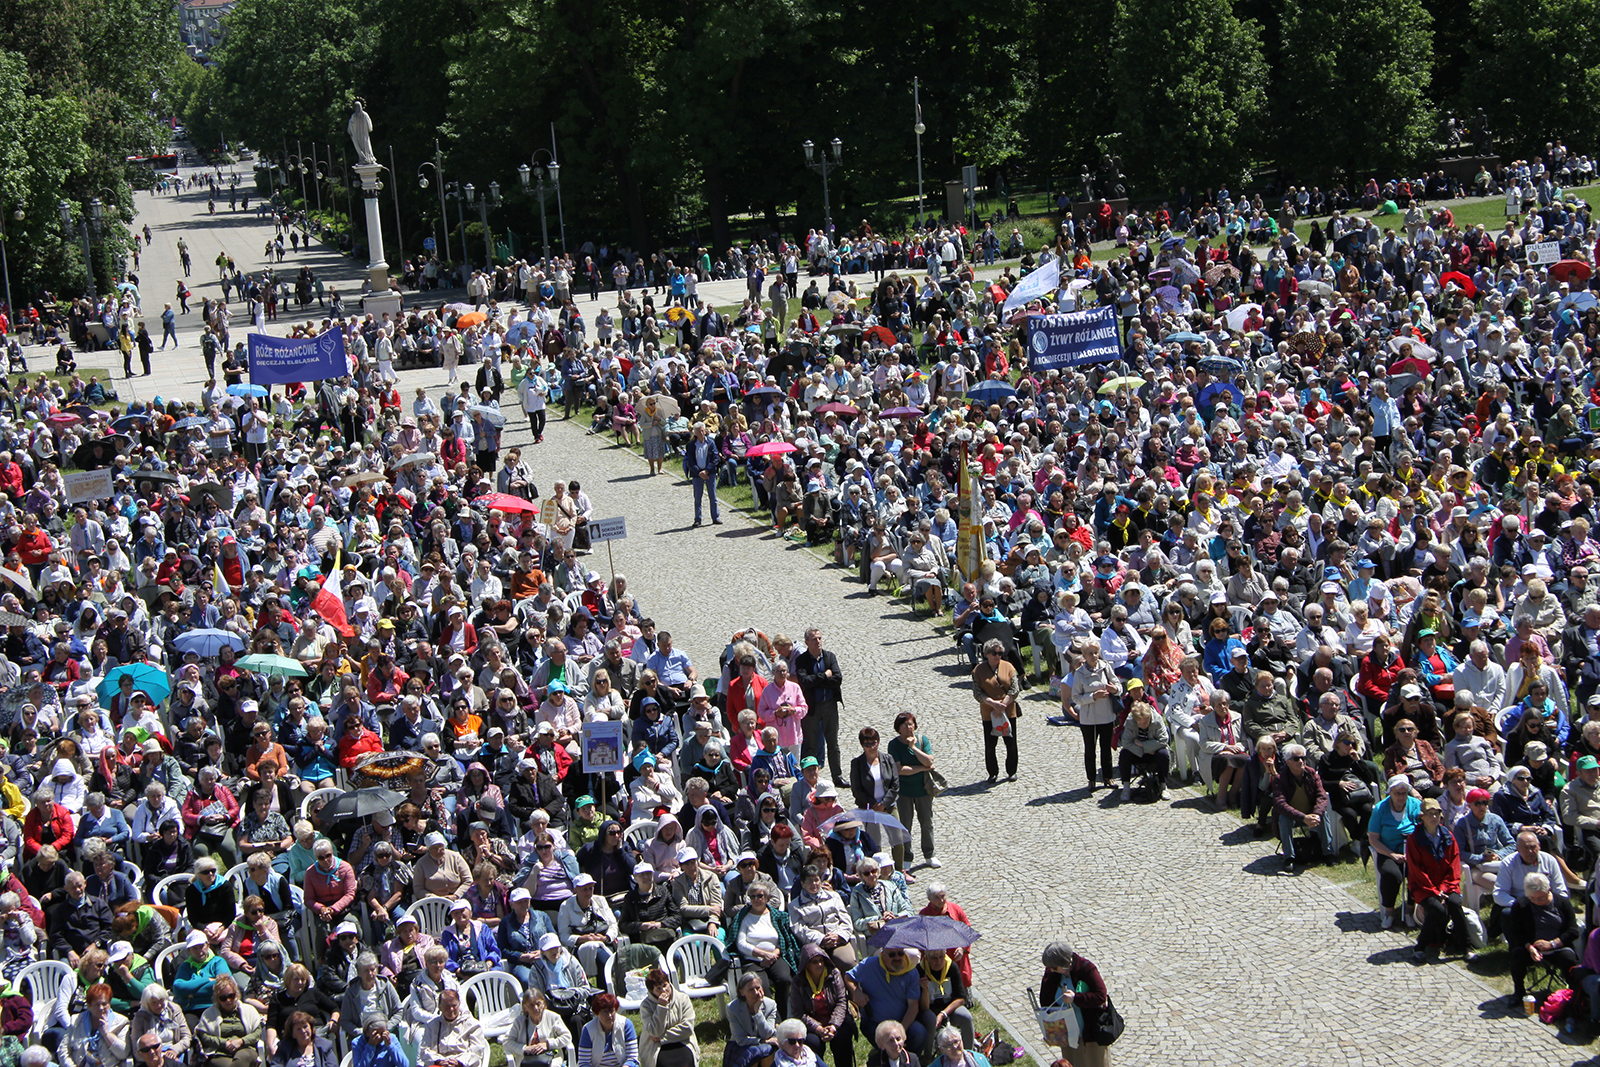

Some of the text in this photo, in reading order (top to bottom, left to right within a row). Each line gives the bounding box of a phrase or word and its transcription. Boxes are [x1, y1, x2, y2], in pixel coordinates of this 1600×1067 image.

[1030, 309, 1114, 330] STOWARZYSZENIE
[1050, 326, 1117, 346] ŻYWY RÓŻANIEC
[255, 343, 273, 358] RÓŻE
[287, 357, 320, 366] ELBLĄSKA
